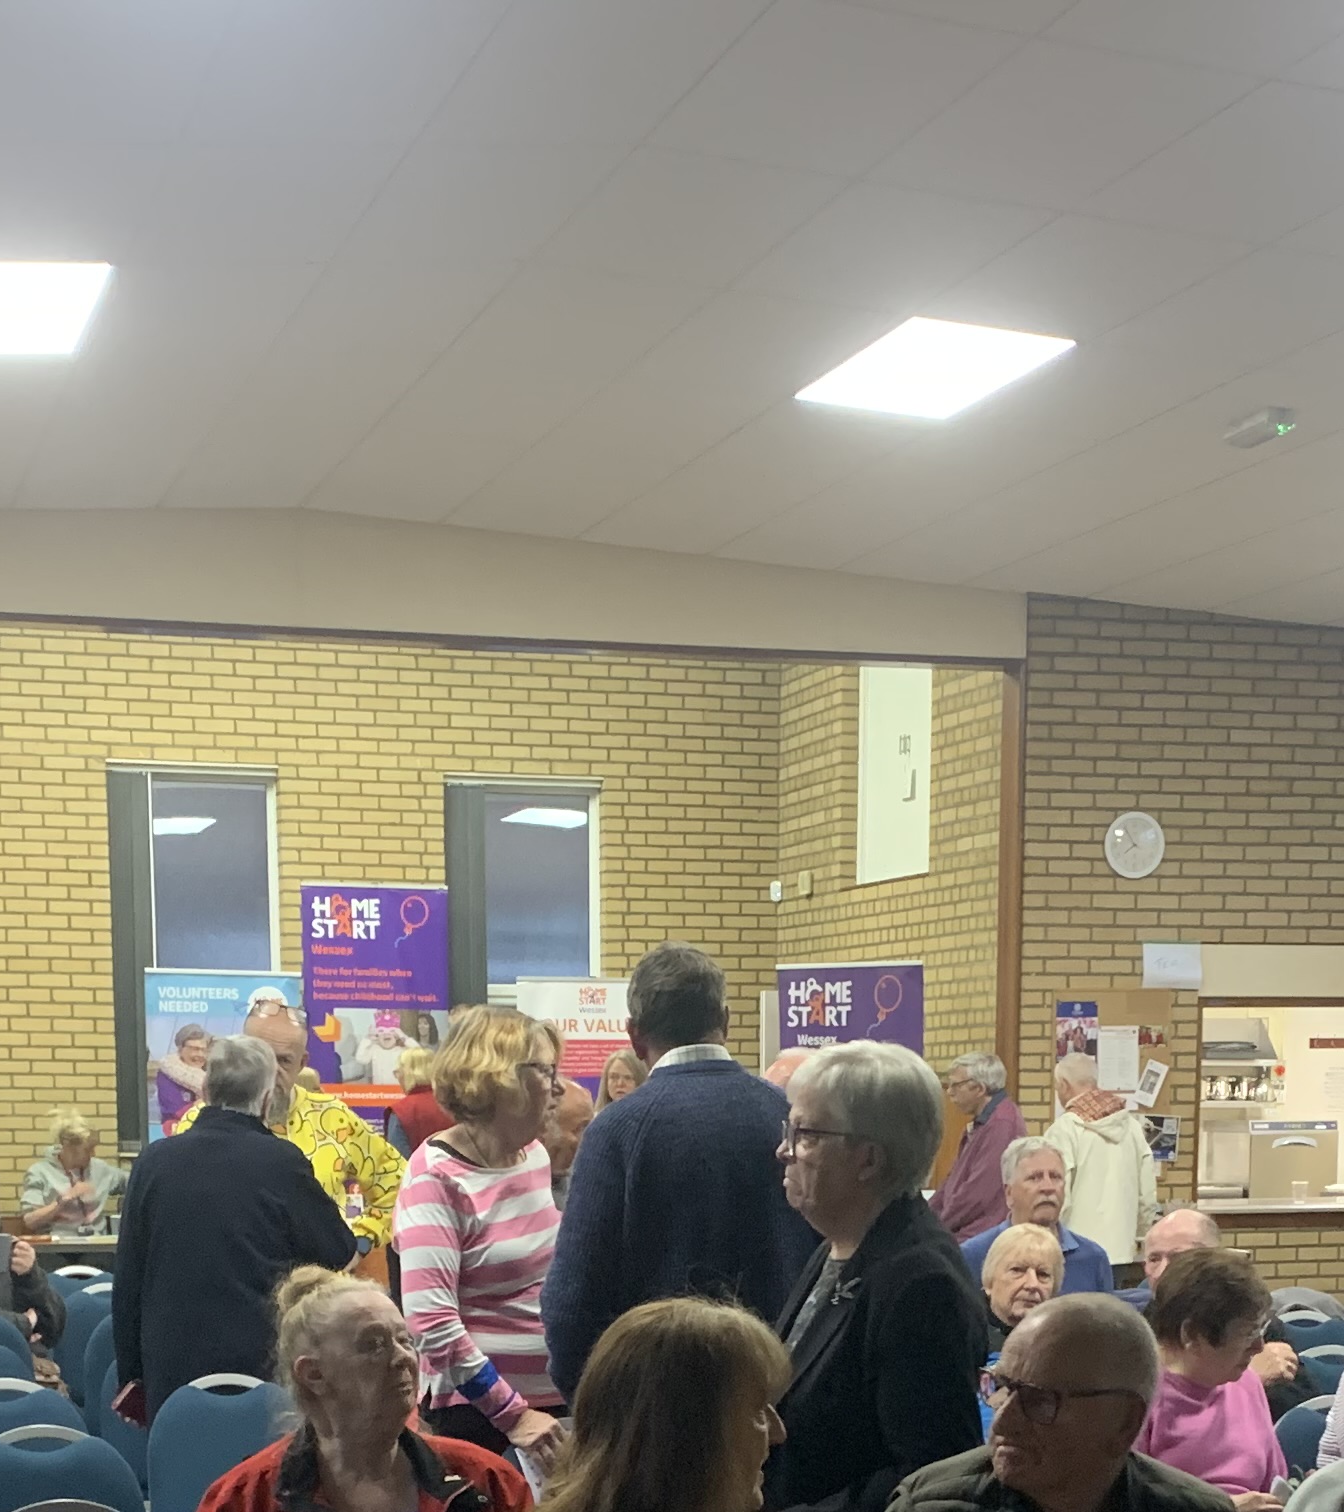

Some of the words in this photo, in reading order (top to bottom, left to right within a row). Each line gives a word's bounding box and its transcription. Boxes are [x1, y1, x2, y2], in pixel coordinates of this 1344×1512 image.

[311, 894, 381, 919] HOME
[311, 918, 381, 940] START
[158, 986, 239, 999] VOLUNTEERS
[788, 978, 853, 1004] HOME
[158, 1001, 208, 1013] NEEDED
[787, 1005, 851, 1027] START
[556, 1018, 578, 1033] UR
[584, 1018, 628, 1033] VALU
[797, 1034, 838, 1046] Wessex
